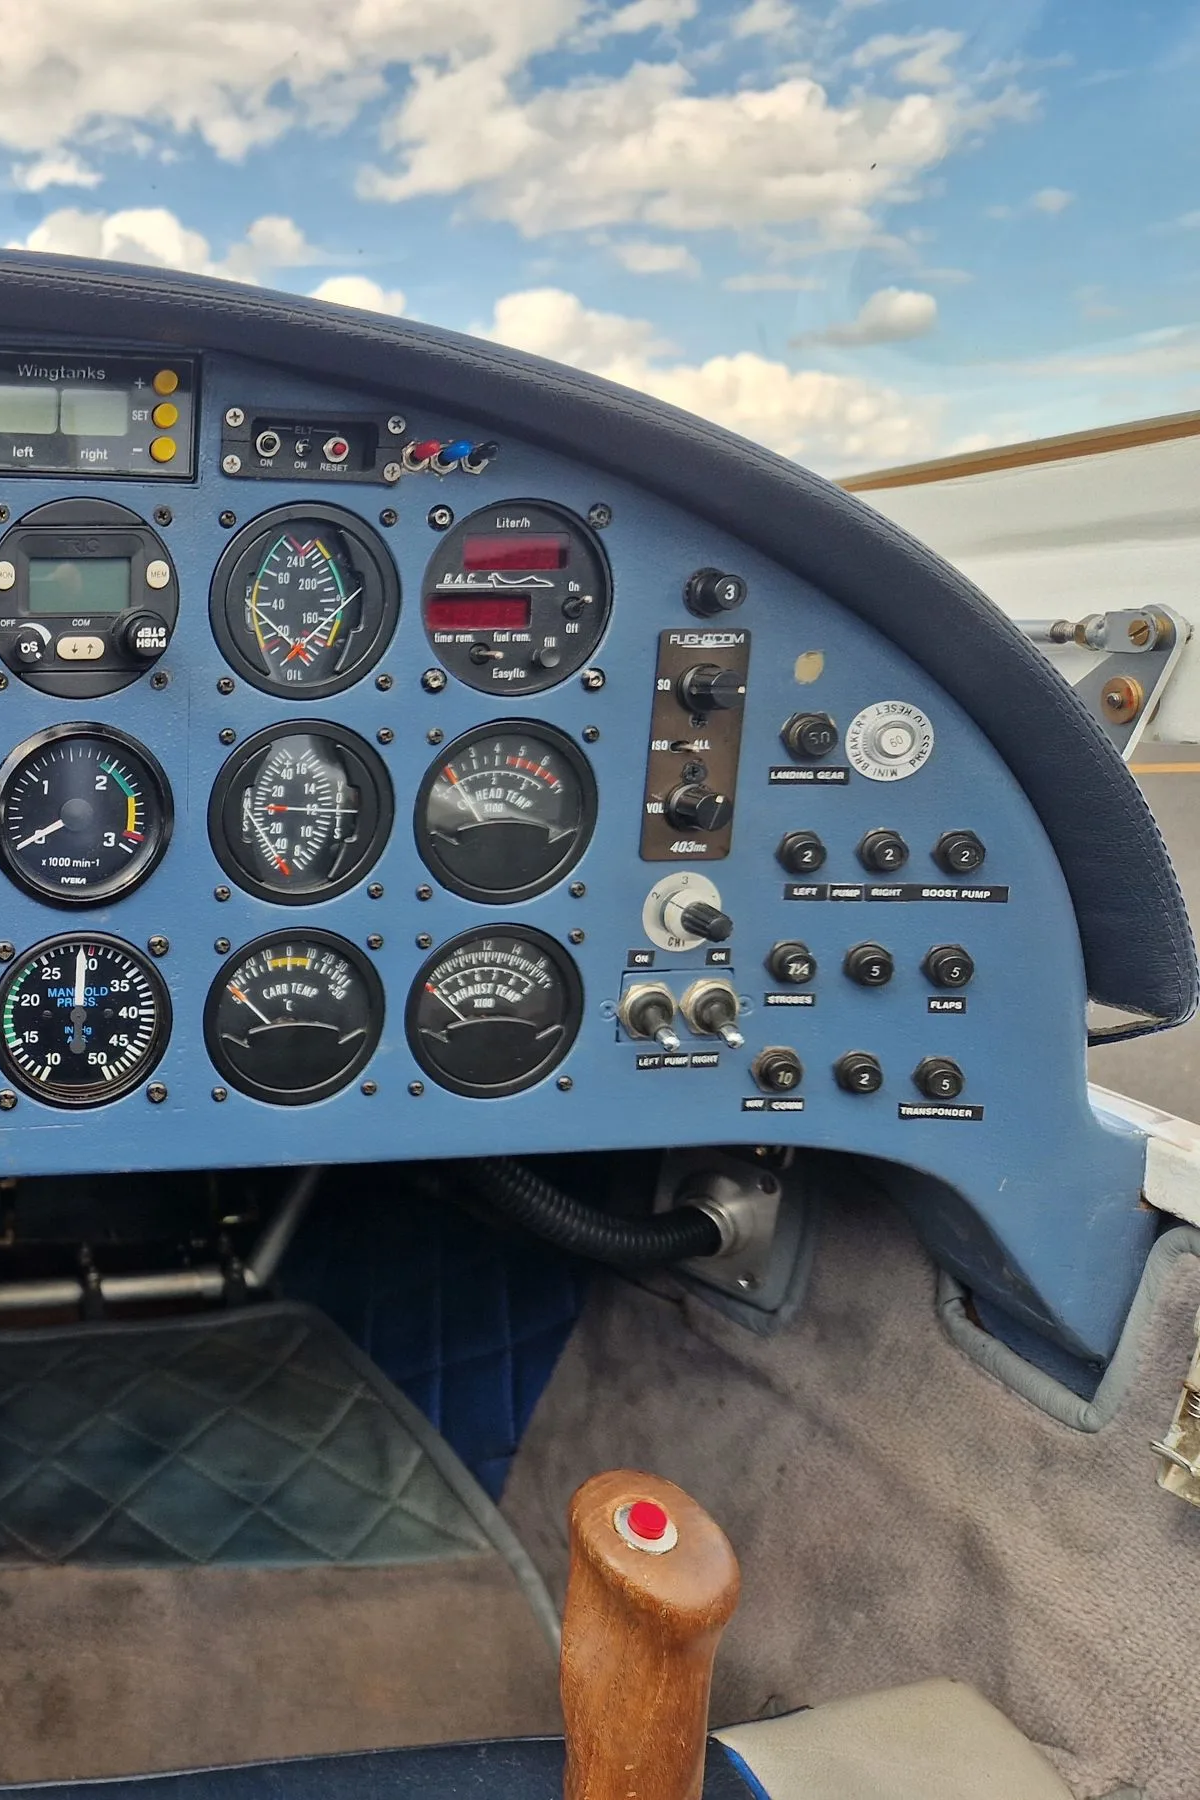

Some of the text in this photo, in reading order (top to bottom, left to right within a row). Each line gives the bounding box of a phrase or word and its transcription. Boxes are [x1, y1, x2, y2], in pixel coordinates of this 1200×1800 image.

[17, 364, 106, 381] Wingtanks
[132, 410, 150, 421] SET
[294, 425, 313, 436] ELT
[12, 446, 34, 458] left
[80, 448, 108, 462] right
[260, 458, 273, 468] ON
[294, 460, 307, 470] ON
[319, 463, 348, 473] RESET
[496, 517, 530, 529] Liter/h
[287, 556, 305, 568] 240
[151, 570, 167, 578] MEM
[277, 573, 290, 585] 60
[298, 579, 317, 590] 200
[568, 581, 580, 591] On
[272, 599, 285, 610] 40
[0, 619, 16, 628] OFF
[71, 619, 90, 627] COM
[302, 612, 318, 624] 160
[137, 627, 166, 637] STEP
[565, 624, 578, 634] Off
[136, 637, 166, 649] PUSH
[434, 633, 475, 643] time rem.
[493, 632, 531, 642] fuel rem.
[544, 637, 556, 648] fill
[287, 669, 302, 681] OIL
[492, 668, 525, 681] Easyflo
[657, 679, 671, 691] SQ
[651, 740, 668, 751] ISO
[850, 720, 870, 772] BREAKER
[281, 768, 293, 780] 40
[296, 763, 307, 775] 16
[770, 770, 845, 780] LANDING GEAR
[872, 768, 898, 777] MINI
[272, 786, 284, 797] 20
[304, 783, 316, 795] 14
[475, 788, 534, 809] HEAD TEMP
[647, 803, 664, 814] VOL
[270, 822, 282, 834] 20
[300, 826, 312, 838] 10
[275, 838, 287, 850] 40
[670, 840, 707, 853] 403mc
[793, 887, 991, 899] LEFT PUMP RIGHT BOOST PUMP
[321, 953, 334, 964] 20
[41, 968, 61, 980] 25
[110, 979, 130, 992] 35
[263, 983, 320, 1000] CARB TEMP
[20, 994, 40, 1007] 20
[448, 983, 523, 1006] EXHAUST TEMP
[767, 995, 813, 1005] STROBES
[930, 1000, 962, 1011] FLAPS
[118, 1007, 138, 1019] 40
[23, 1031, 39, 1043] 15
[108, 1034, 129, 1047] 45
[45, 1053, 61, 1065] 10
[87, 1052, 107, 1065] 50
[638, 1054, 719, 1066] LEFT PUMP RIGHT
[778, 1071, 793, 1085] 10
[901, 1107, 973, 1117] TRANSPONDER
